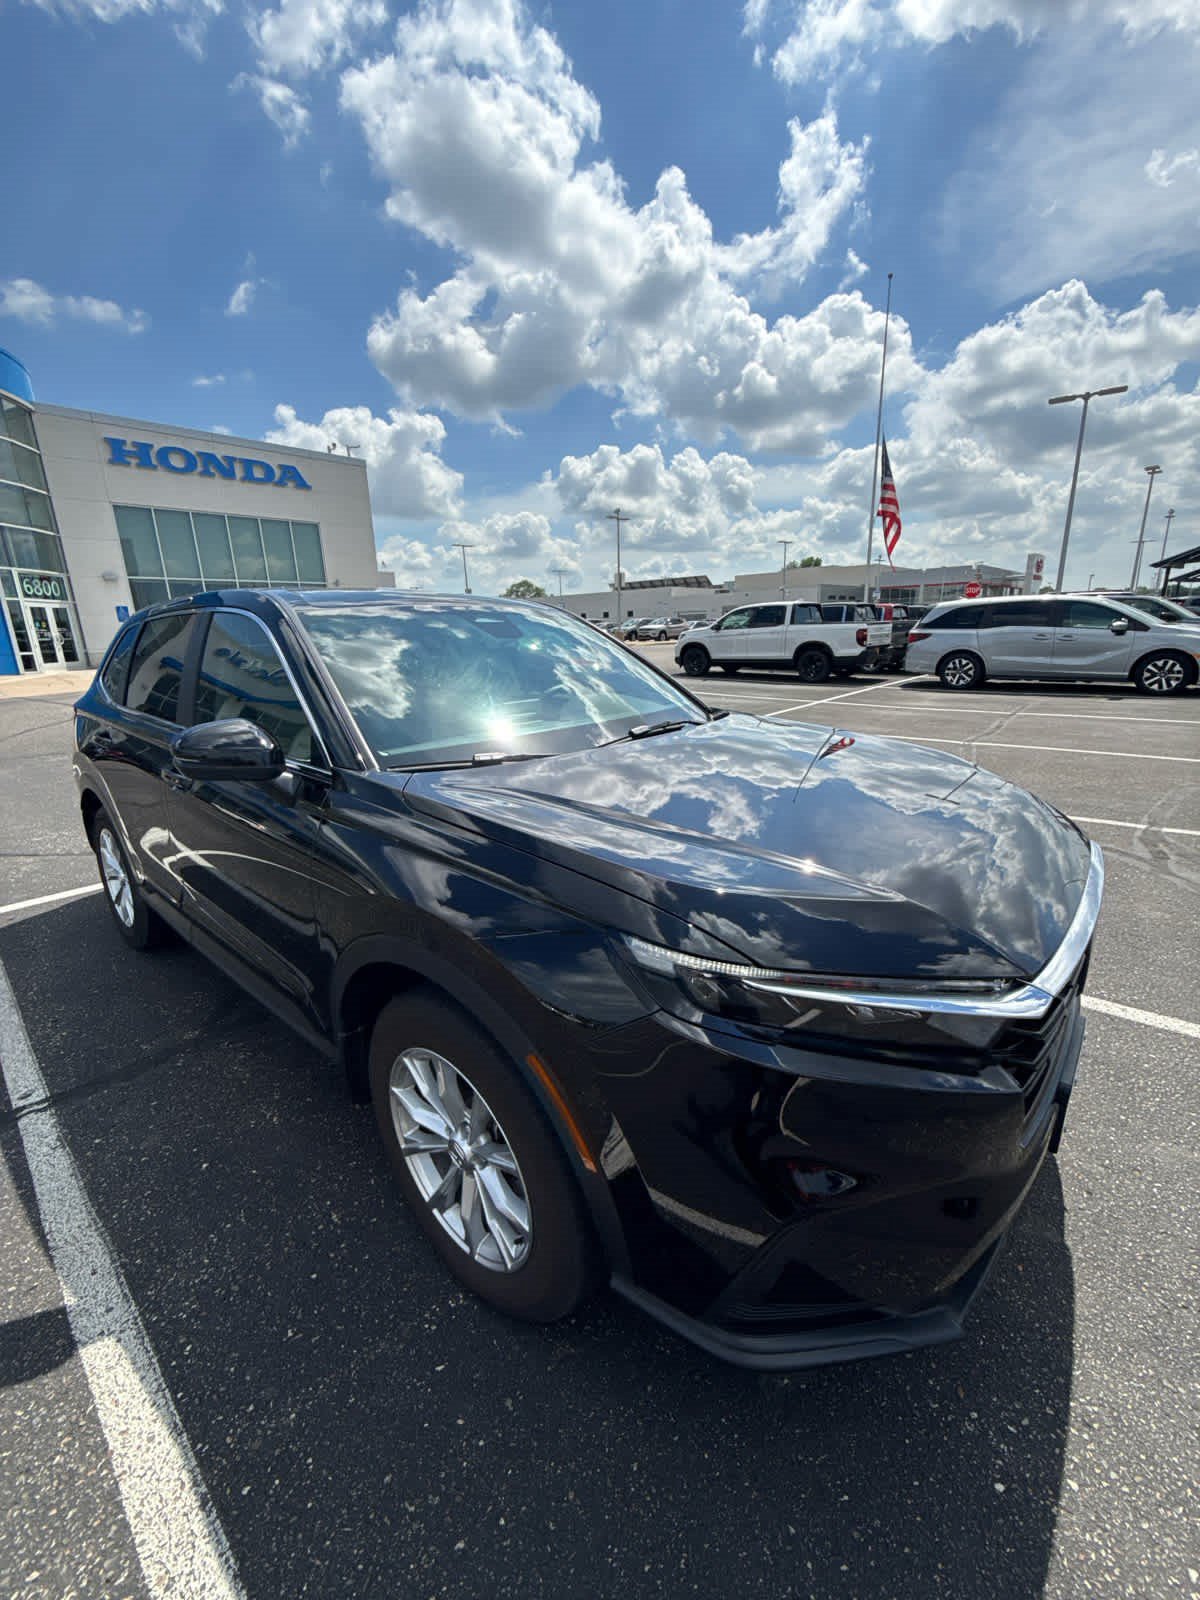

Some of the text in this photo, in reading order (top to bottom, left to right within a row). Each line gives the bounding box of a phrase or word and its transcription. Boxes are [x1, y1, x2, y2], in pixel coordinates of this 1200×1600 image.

[104, 437, 312, 490] HONDA
[23, 578, 60, 597] 6800
[966, 586, 981, 594] STOP
